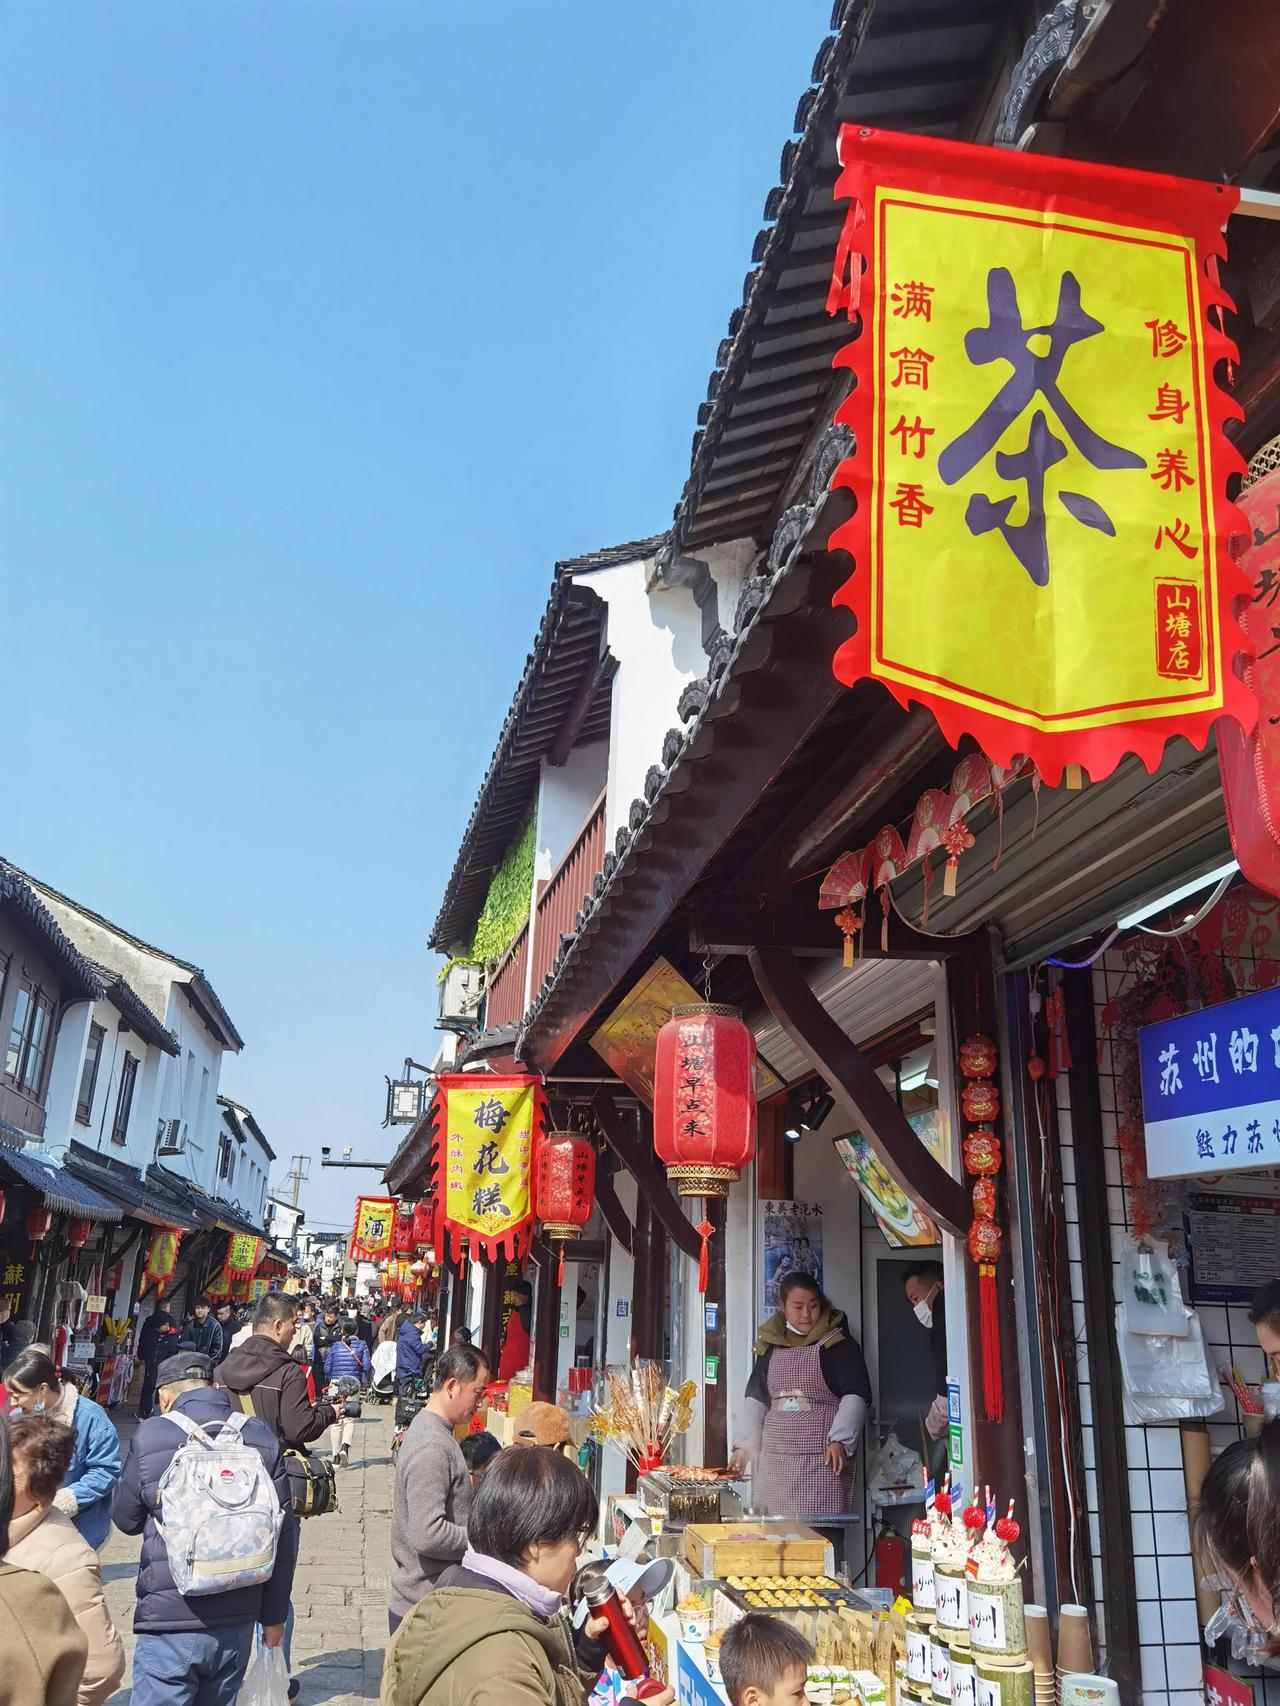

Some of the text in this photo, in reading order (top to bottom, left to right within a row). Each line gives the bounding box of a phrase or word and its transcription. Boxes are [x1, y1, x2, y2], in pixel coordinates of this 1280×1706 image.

[889, 280, 937, 529] 满筒竹香
[938, 267, 1147, 587] 茶
[1145, 318, 1199, 559] 修身养心
[1164, 586, 1194, 672] 山塘店
[681, 1034, 706, 1138] 山塘早点来
[472, 1097, 511, 1217] 梅花糕
[365, 1216, 386, 1238] 酒
